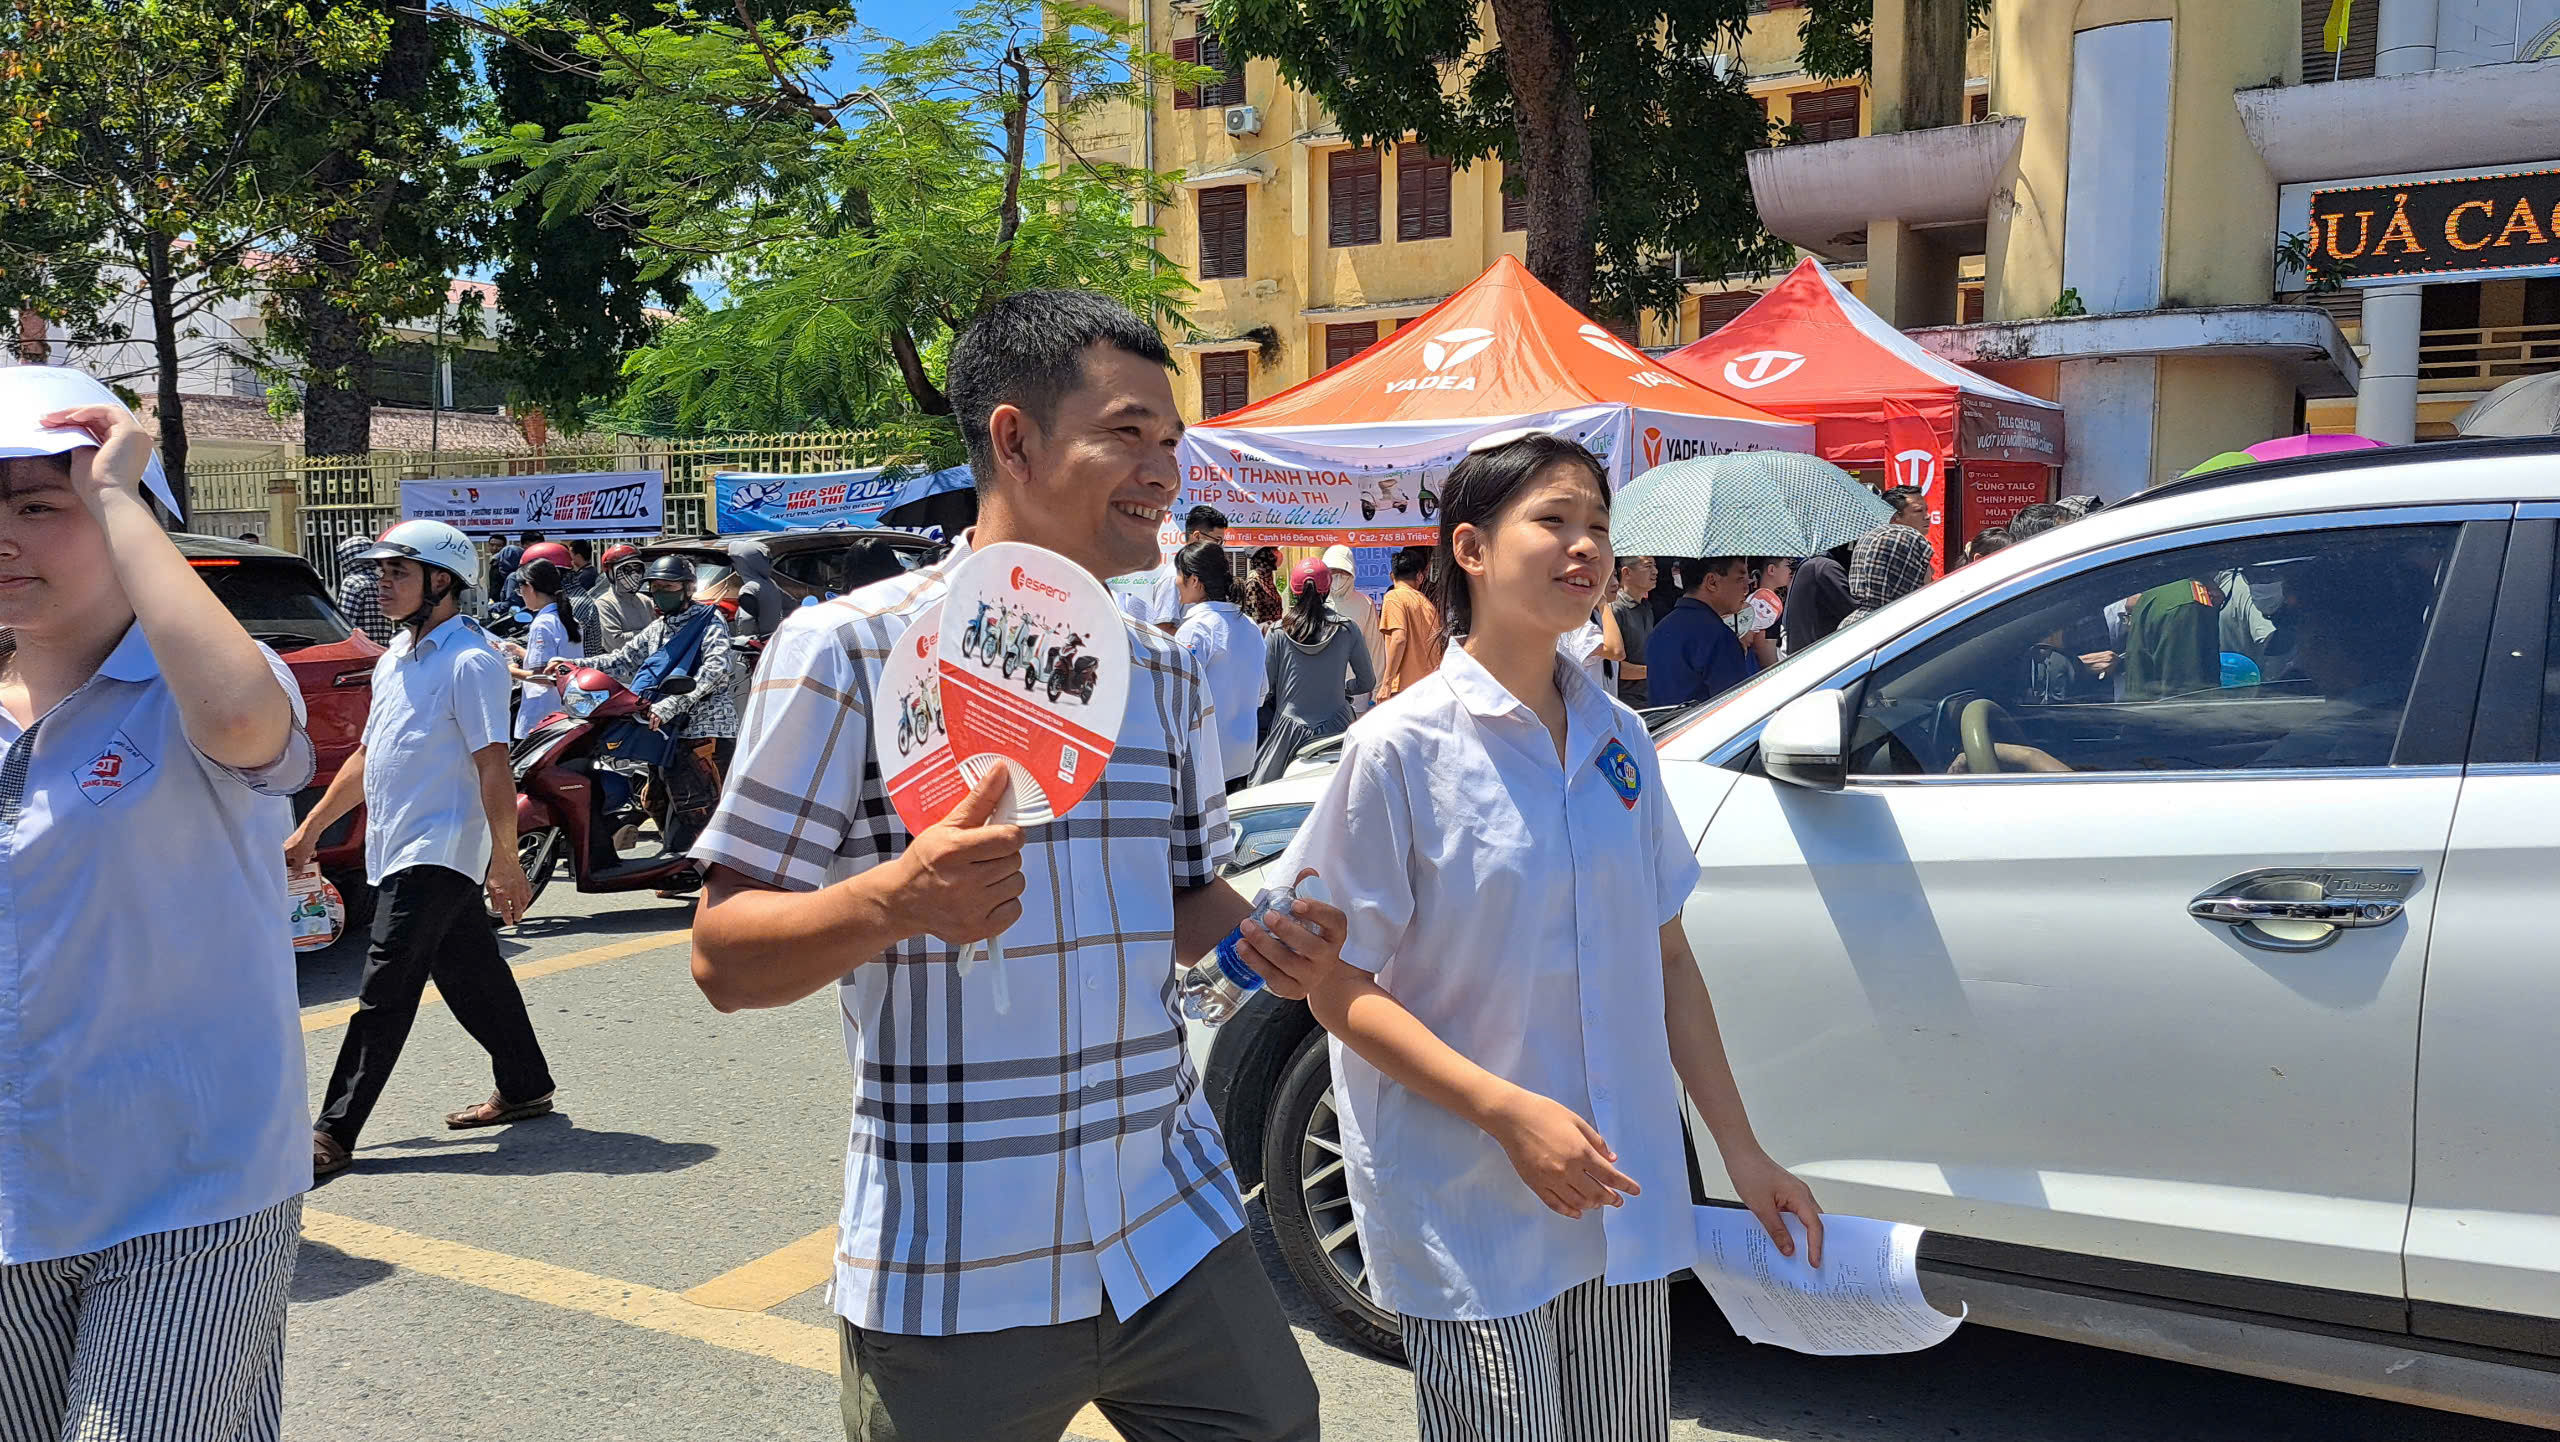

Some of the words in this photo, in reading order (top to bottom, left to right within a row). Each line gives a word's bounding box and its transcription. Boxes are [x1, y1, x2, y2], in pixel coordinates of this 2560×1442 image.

[2308, 193, 2427, 261] UẢ
[1384, 375, 1477, 394] YADEA
[1239, 467, 1303, 486] THANH
[1976, 481, 2005, 490] CÙNG
[2007, 482, 2036, 490] TAILG
[592, 486, 642, 517] 2026
[788, 488, 817, 502] TIẾP
[818, 484, 848, 498] SỨC
[820, 495, 844, 506] THI
[1187, 485, 1222, 503] TIẾP
[1261, 488, 1300, 505] MÙA
[1301, 492, 1329, 504] THI
[2008, 495, 2036, 505] PHỤC
[575, 506, 592, 520] THI
[1985, 507, 2007, 516] MÙA
[1025, 577, 1067, 602] espero
